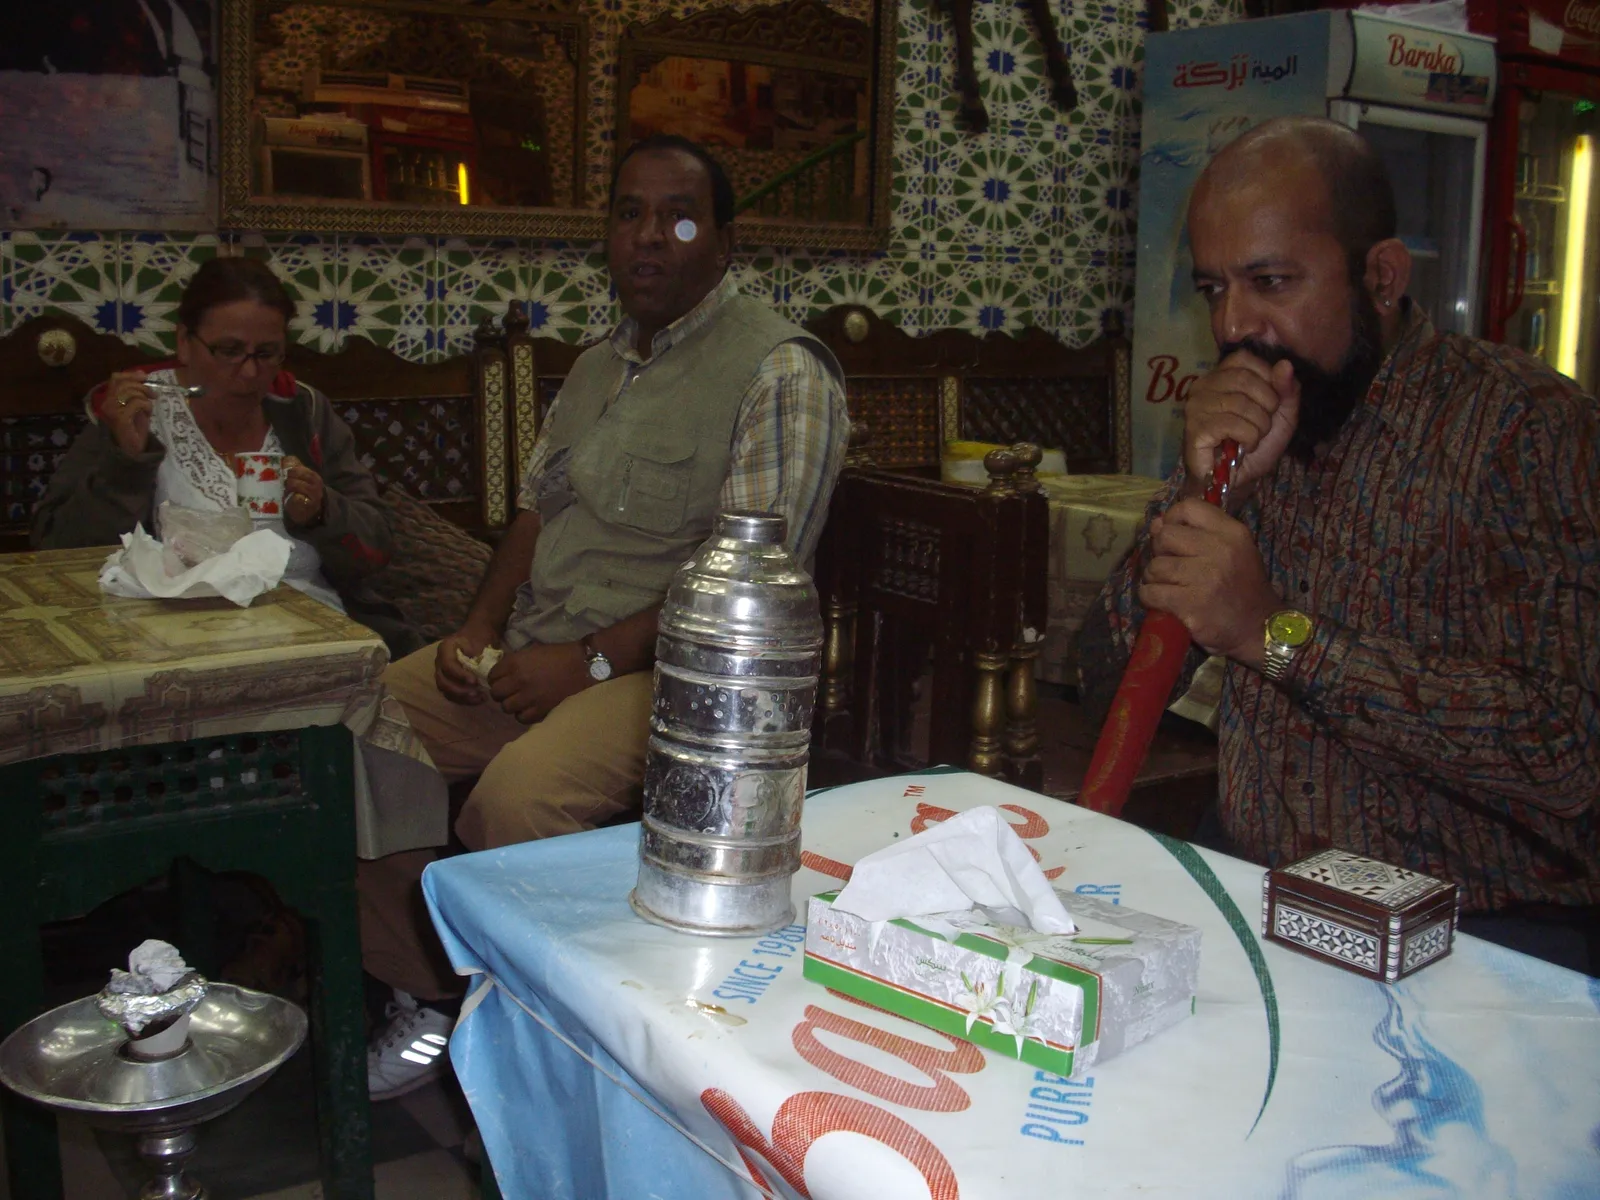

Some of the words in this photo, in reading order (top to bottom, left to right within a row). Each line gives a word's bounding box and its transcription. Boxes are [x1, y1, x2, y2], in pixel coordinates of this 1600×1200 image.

[1387, 33, 1457, 76] Baraka
[712, 959, 783, 1004] SINCE
[1020, 1070, 1095, 1146] PURE
